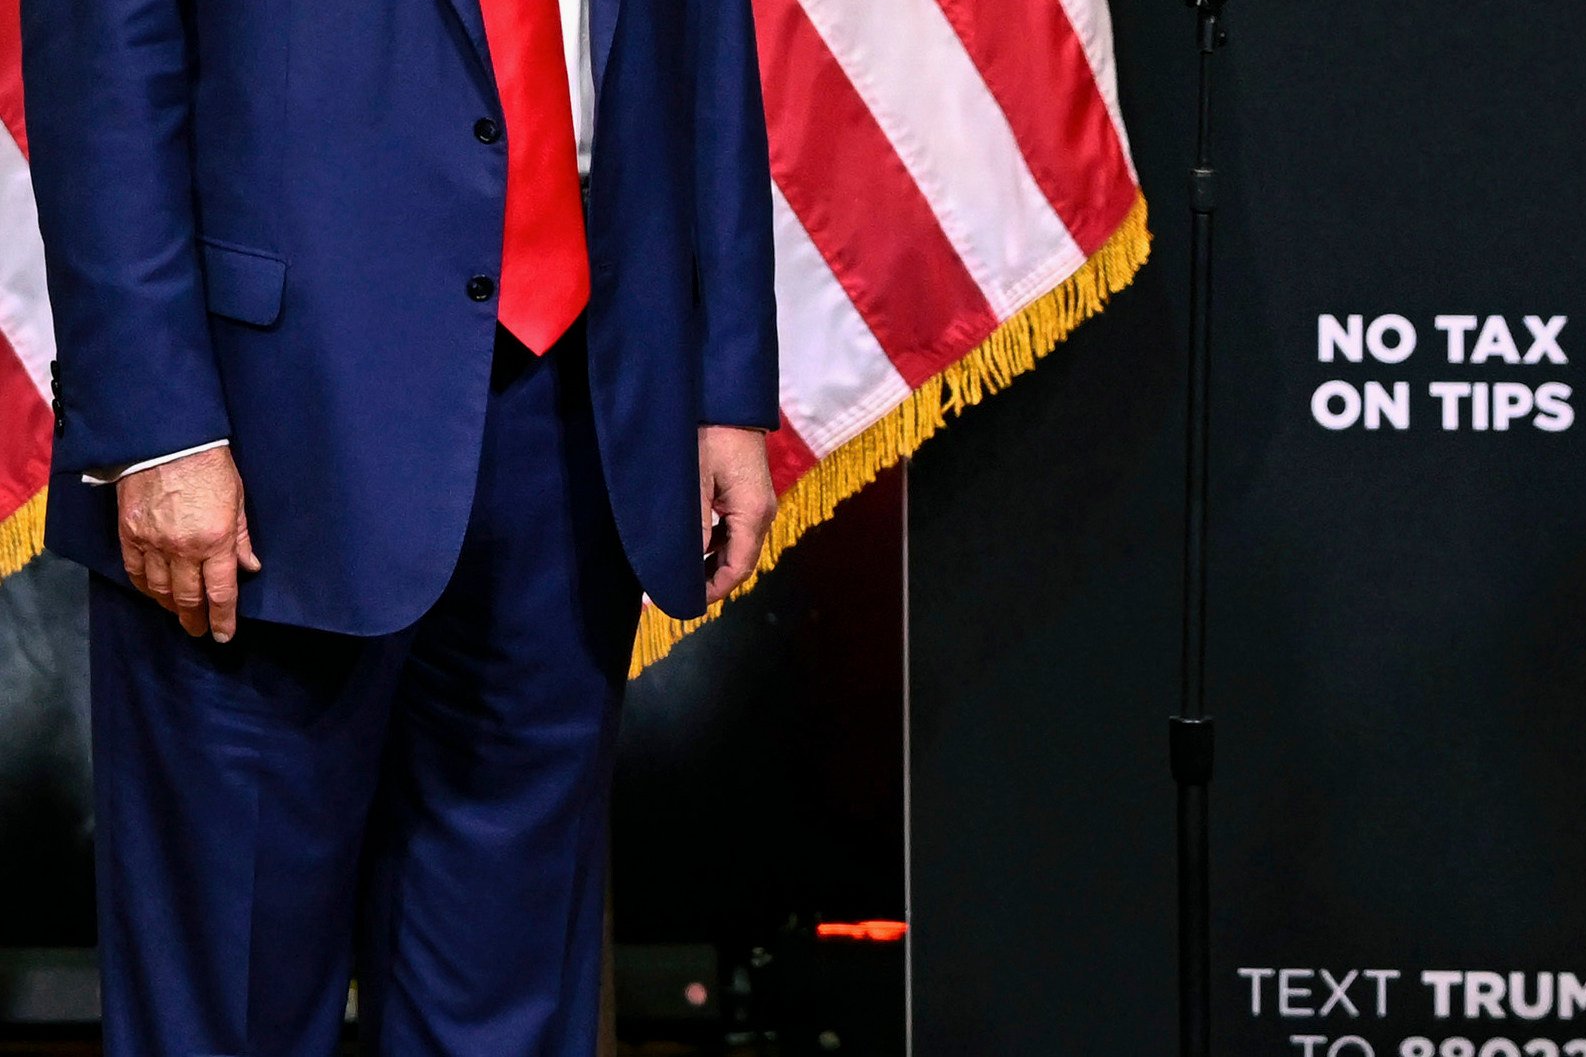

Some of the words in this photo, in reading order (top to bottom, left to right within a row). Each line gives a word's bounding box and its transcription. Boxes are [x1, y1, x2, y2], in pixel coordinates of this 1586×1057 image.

[1317, 313, 1417, 364] NO
[1434, 314, 1568, 365] TAX
[1310, 379, 1410, 430] ON
[1428, 381, 1575, 432] TIPS
[1237, 967, 1401, 1017] TEXT
